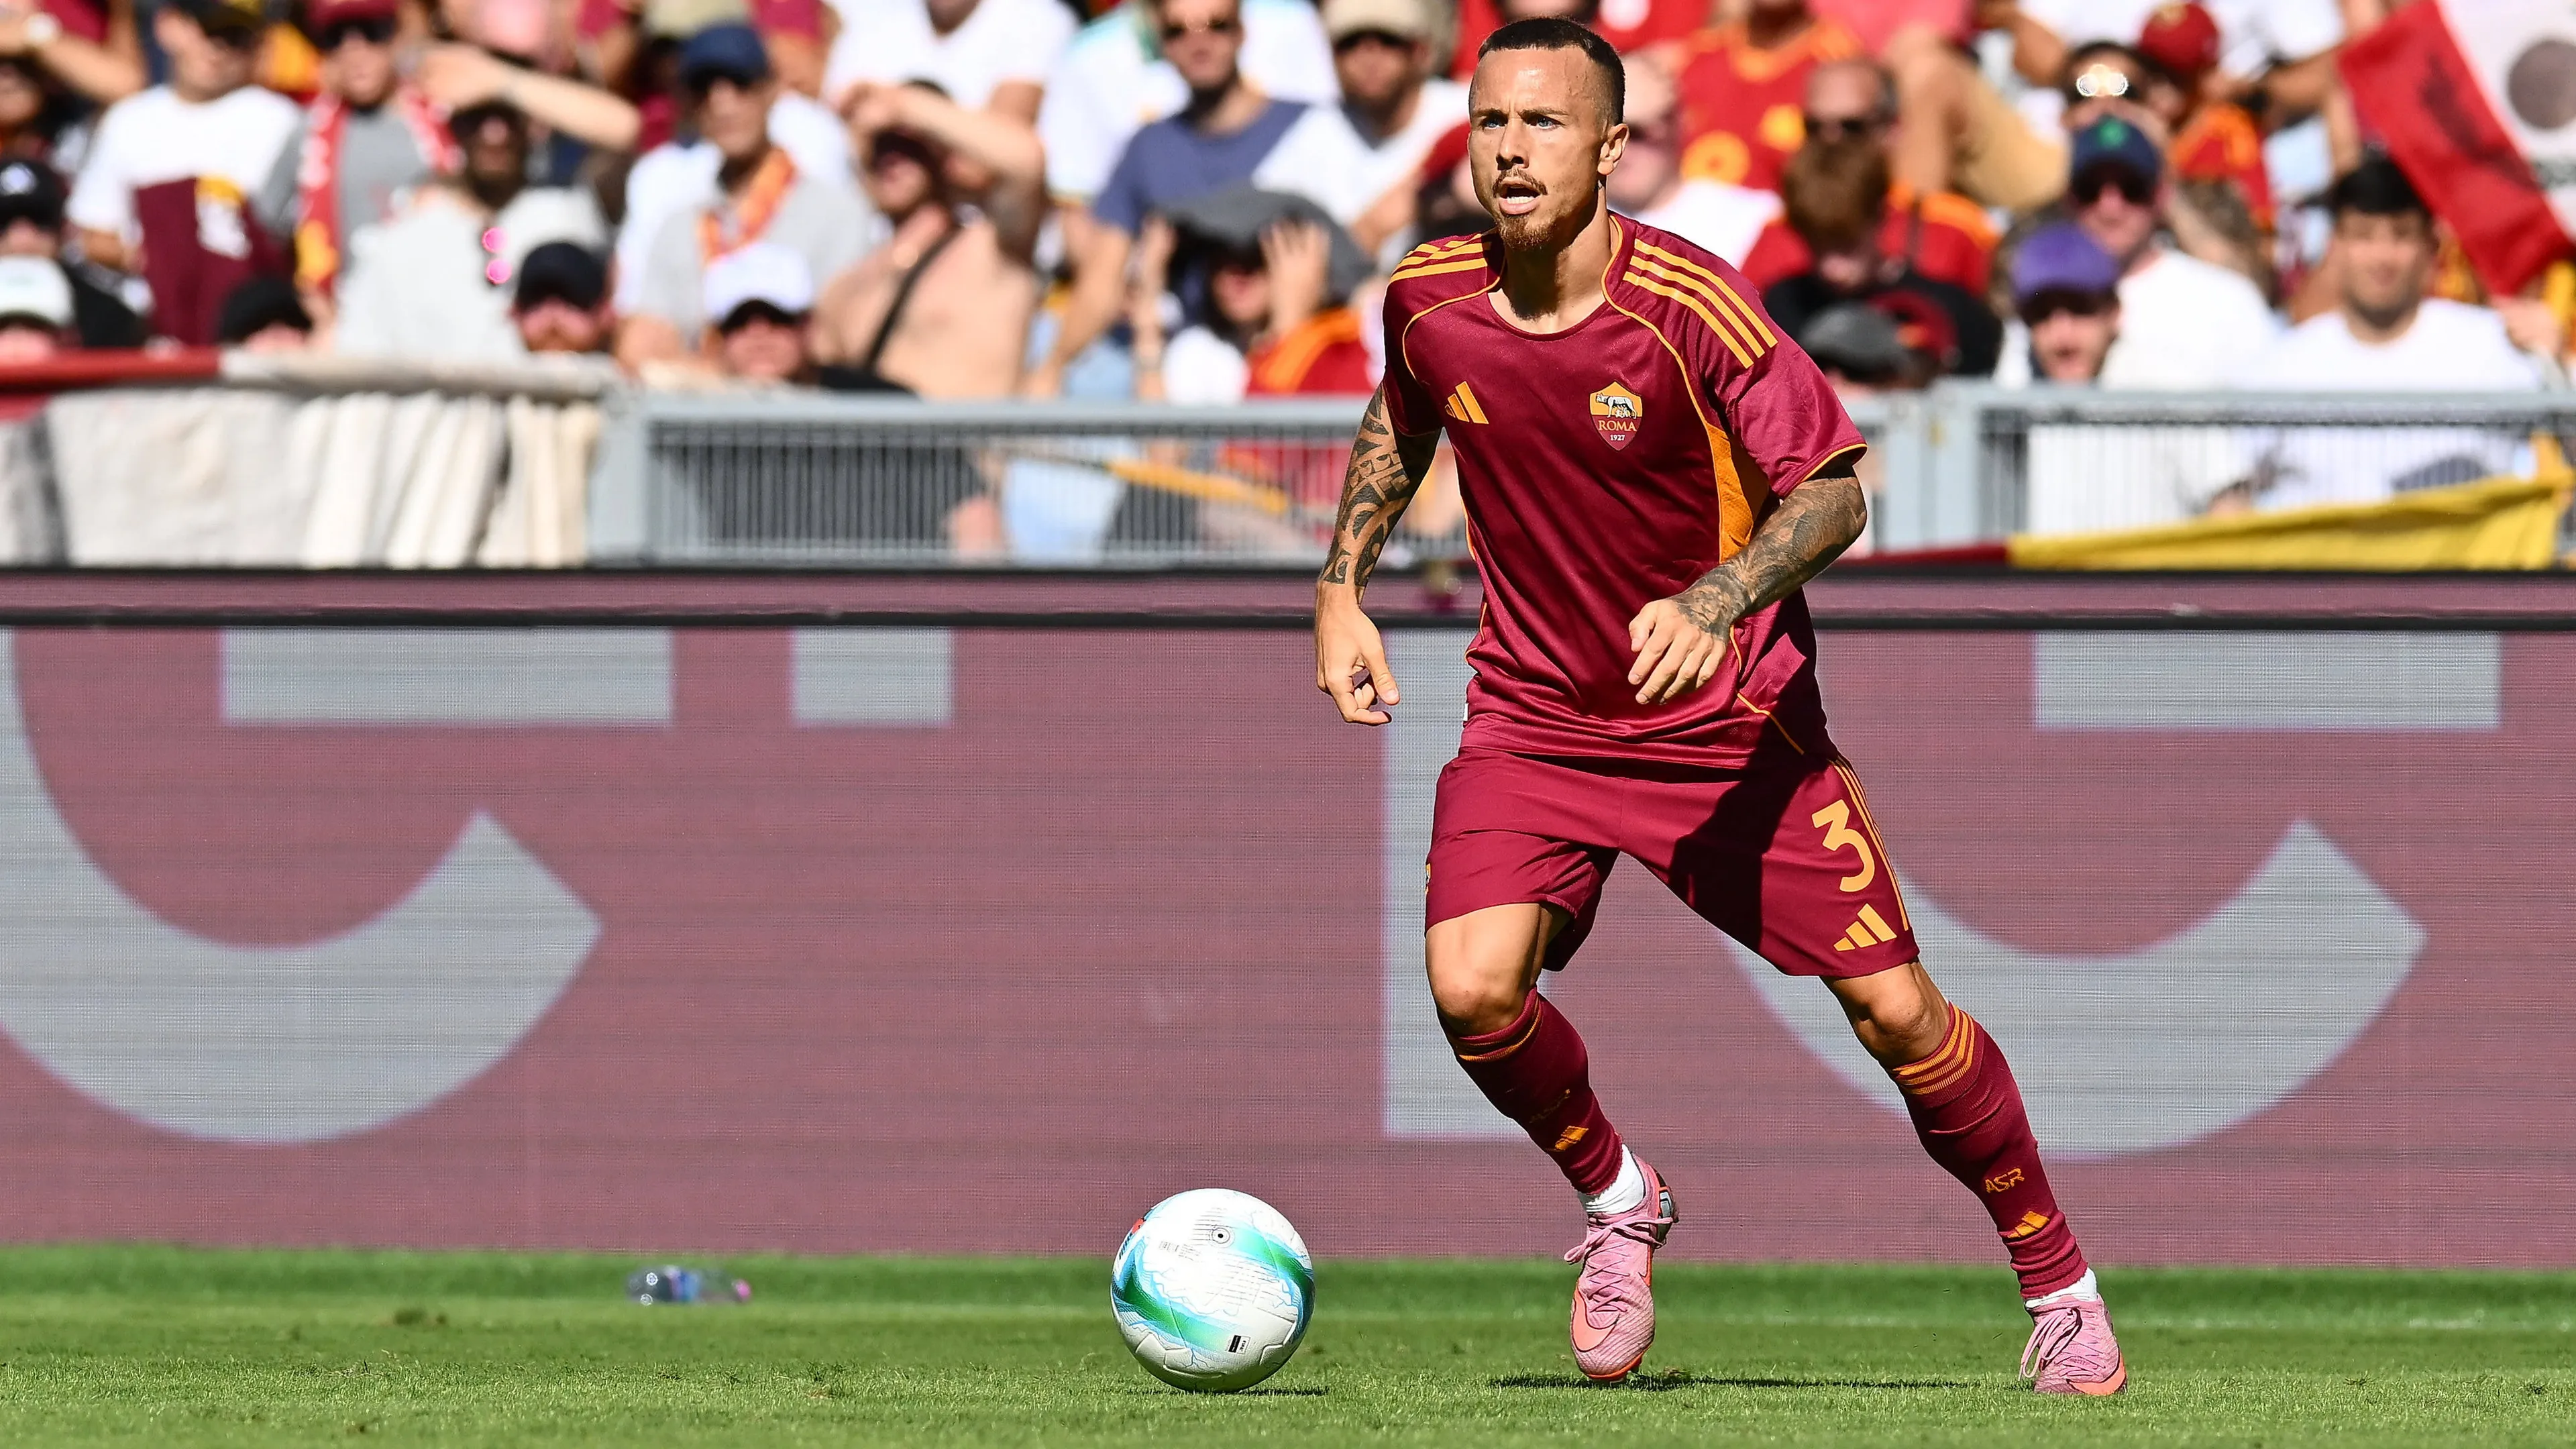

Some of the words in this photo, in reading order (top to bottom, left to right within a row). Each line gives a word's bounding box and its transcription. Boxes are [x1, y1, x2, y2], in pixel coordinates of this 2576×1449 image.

[1598, 420, 1637, 431] ROMA
[1811, 799, 1875, 892] 3
[1985, 1168, 2025, 1193] ASR
